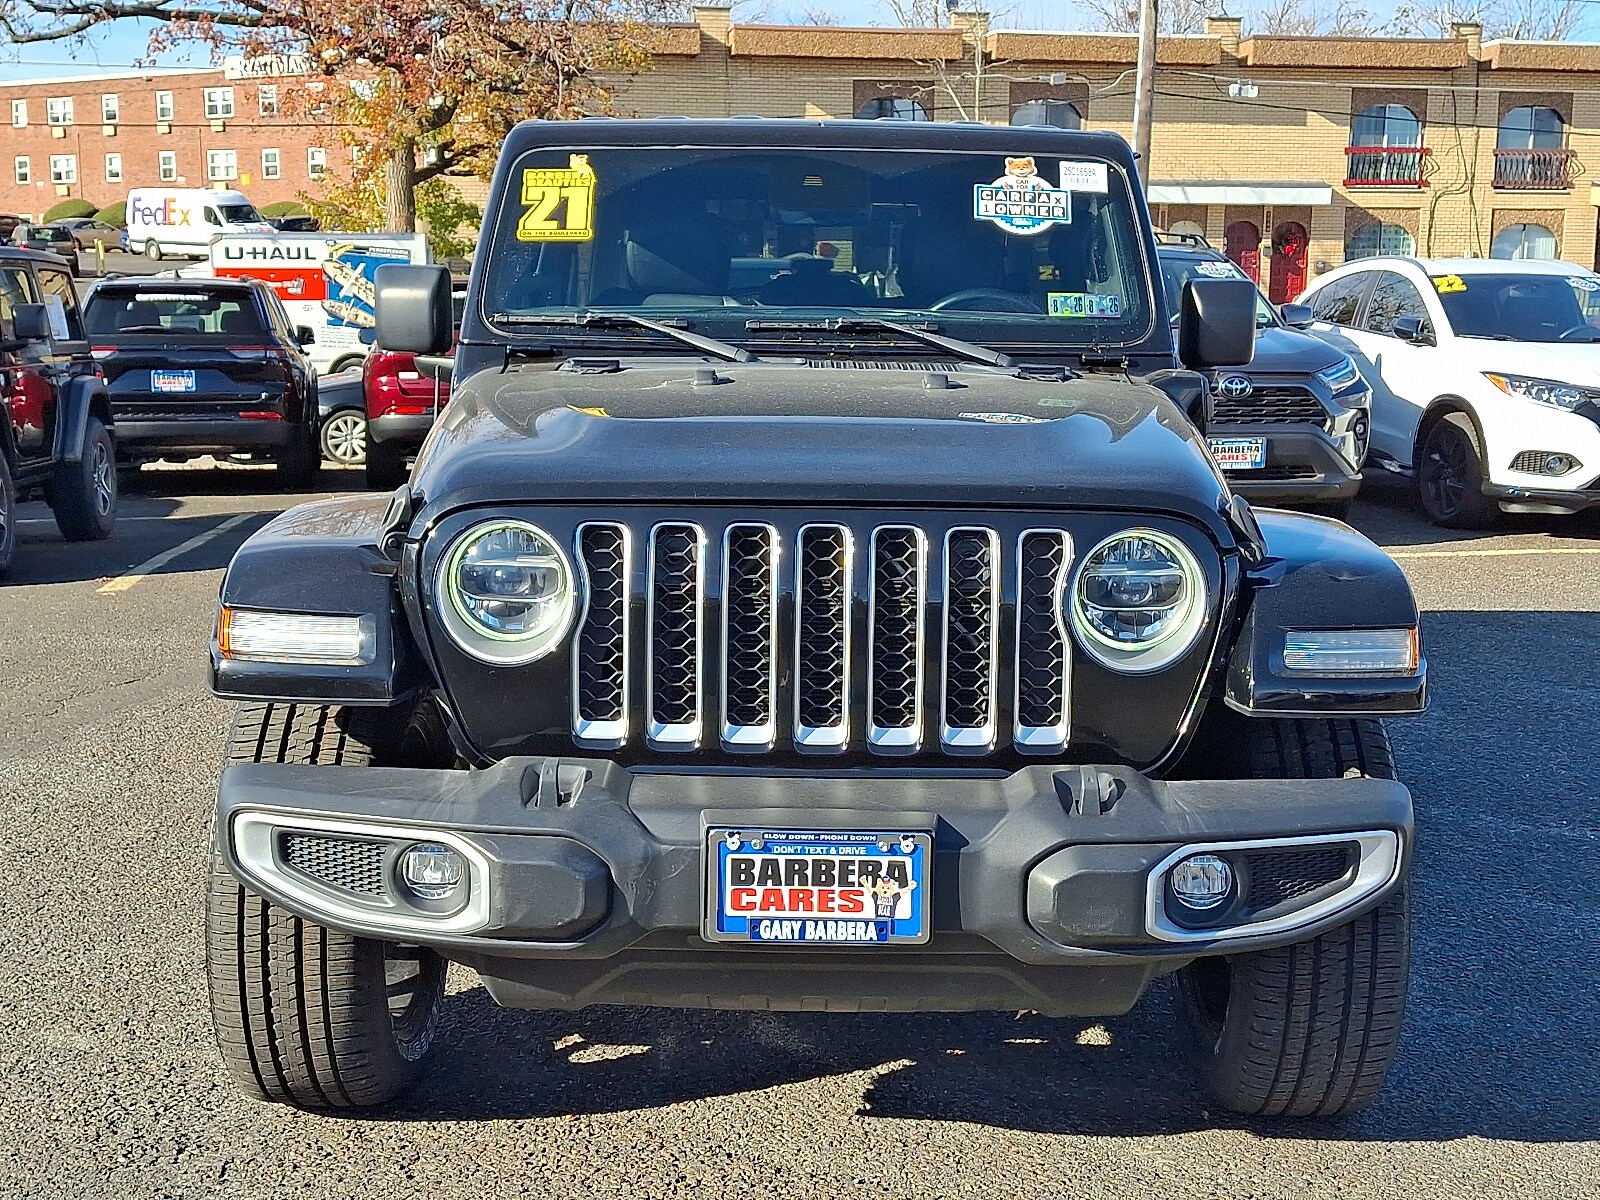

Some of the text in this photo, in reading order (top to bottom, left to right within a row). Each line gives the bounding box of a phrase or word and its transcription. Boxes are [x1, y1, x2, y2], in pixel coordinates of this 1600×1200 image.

[980, 188, 1063, 205] CARFAX
[131, 196, 192, 227] FedEx
[522, 186, 590, 230] 21
[984, 202, 1066, 218] 1 OWNER
[224, 246, 317, 261] U-HAUL
[1052, 297, 1083, 313] 8 26
[1088, 297, 1119, 313] 8 26
[1212, 445, 1260, 454] BARBERA
[773, 845, 868, 855] DON'T TEXT & DRIVE
[730, 857, 909, 888] BARBERA
[730, 888, 865, 913] CARES
[759, 919, 878, 942] GARY BARBERA
